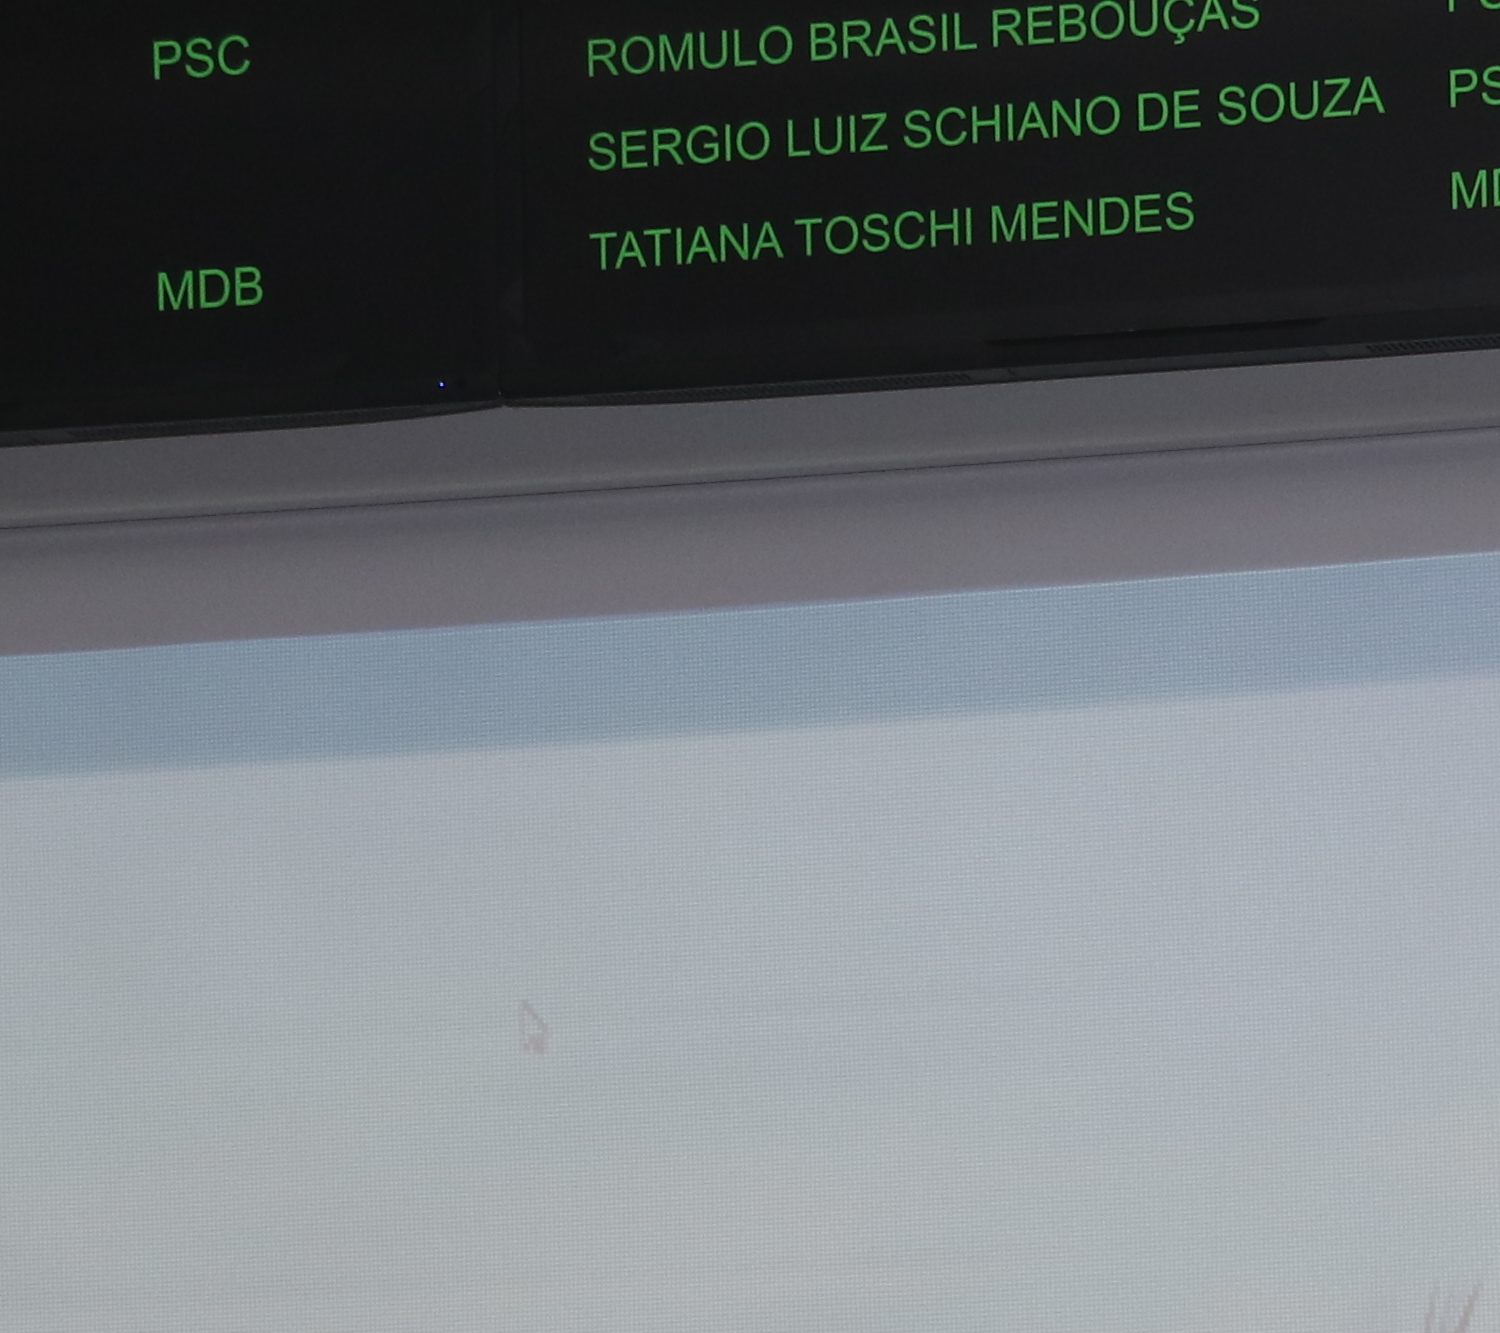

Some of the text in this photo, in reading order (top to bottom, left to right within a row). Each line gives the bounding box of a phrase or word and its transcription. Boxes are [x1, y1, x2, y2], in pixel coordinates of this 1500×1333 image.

[152, 34, 252, 80] PSC
[587, 0, 1261, 76] ROMULO BRASIL REBOUÇAS
[588, 120, 771, 170] SERGIO
[786, 112, 889, 157] LUIZ
[902, 94, 1122, 148] SCHIANO
[1137, 88, 1204, 132] DE
[1217, 76, 1386, 127] SOUZA
[589, 221, 785, 270] TATIANA
[794, 208, 973, 256] TOSCHI
[990, 190, 1196, 243] MENDES
[157, 265, 264, 311] MDB
